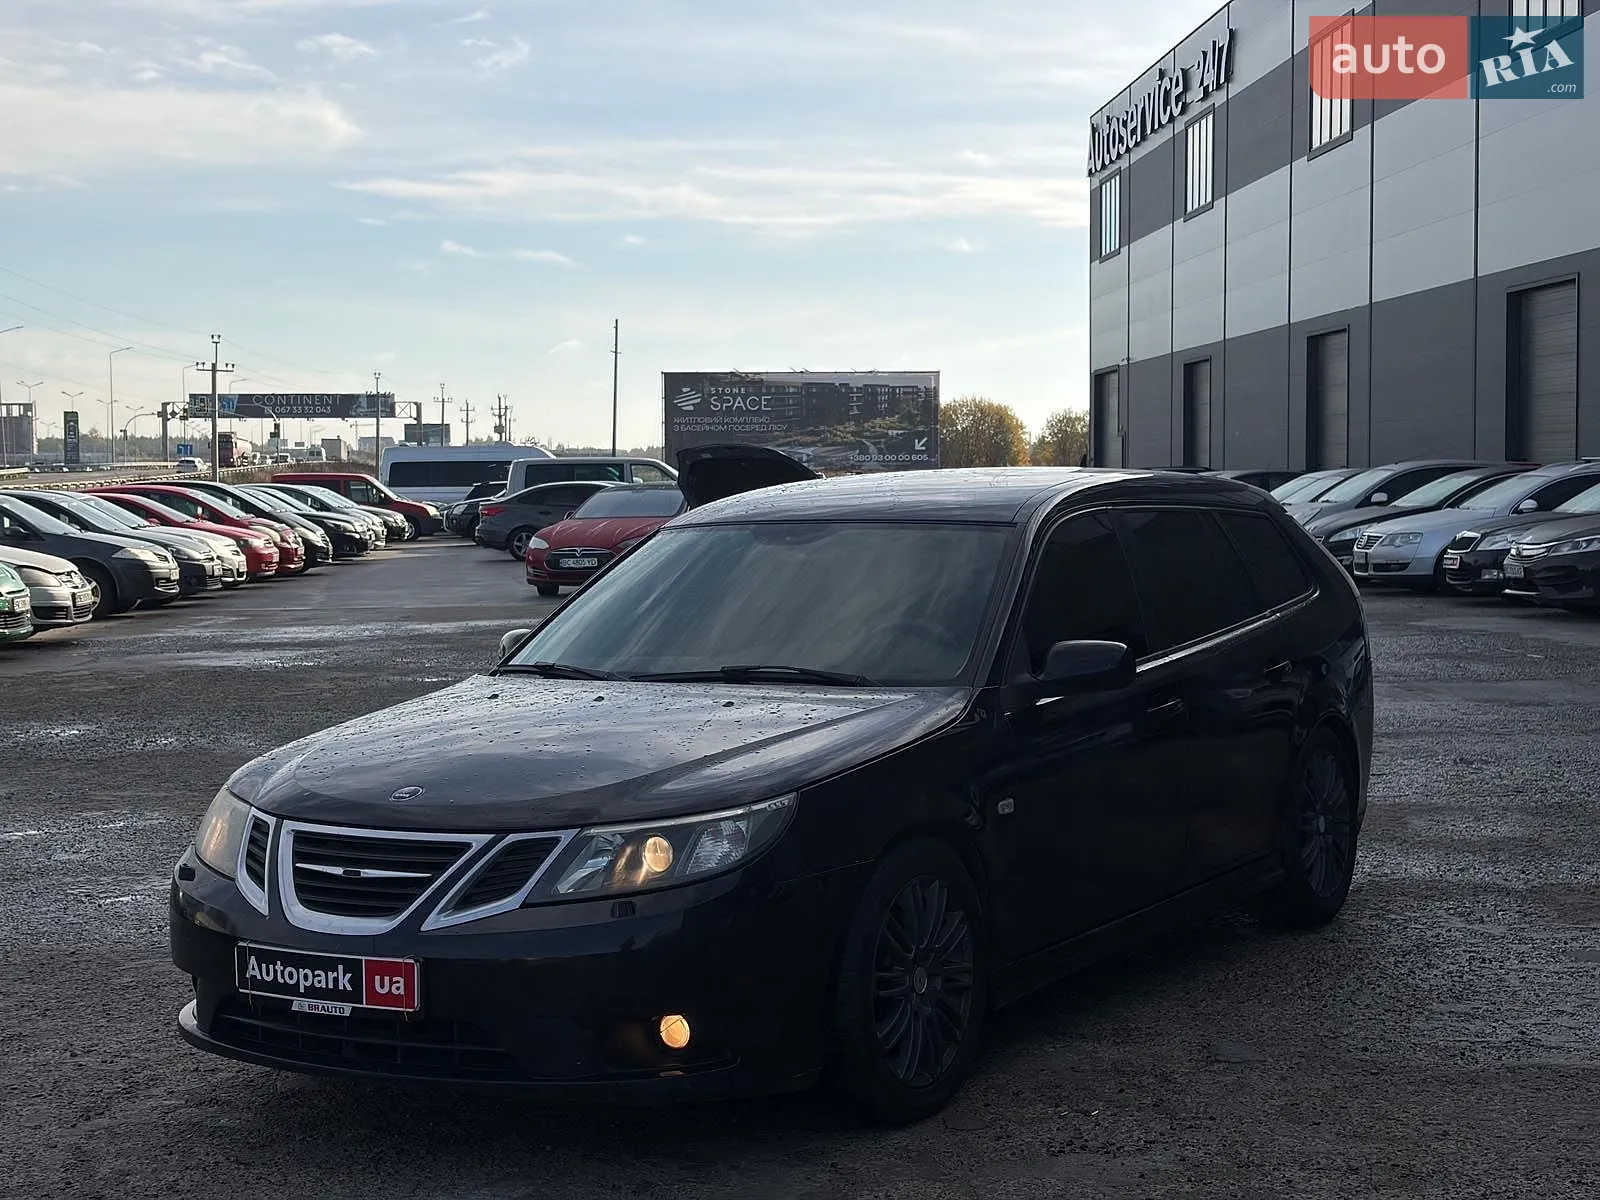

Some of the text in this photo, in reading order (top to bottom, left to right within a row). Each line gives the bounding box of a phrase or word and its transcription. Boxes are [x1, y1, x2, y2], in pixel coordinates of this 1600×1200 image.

[1087, 28, 1232, 175] Autoservice 24/7
[252, 394, 341, 405] CONTINENT
[710, 396, 772, 411] SPACE
[275, 406, 290, 414] 067
[304, 406, 314, 414] 32
[246, 955, 404, 995] Autopark ua
[308, 1003, 345, 1014] BRAUTO
